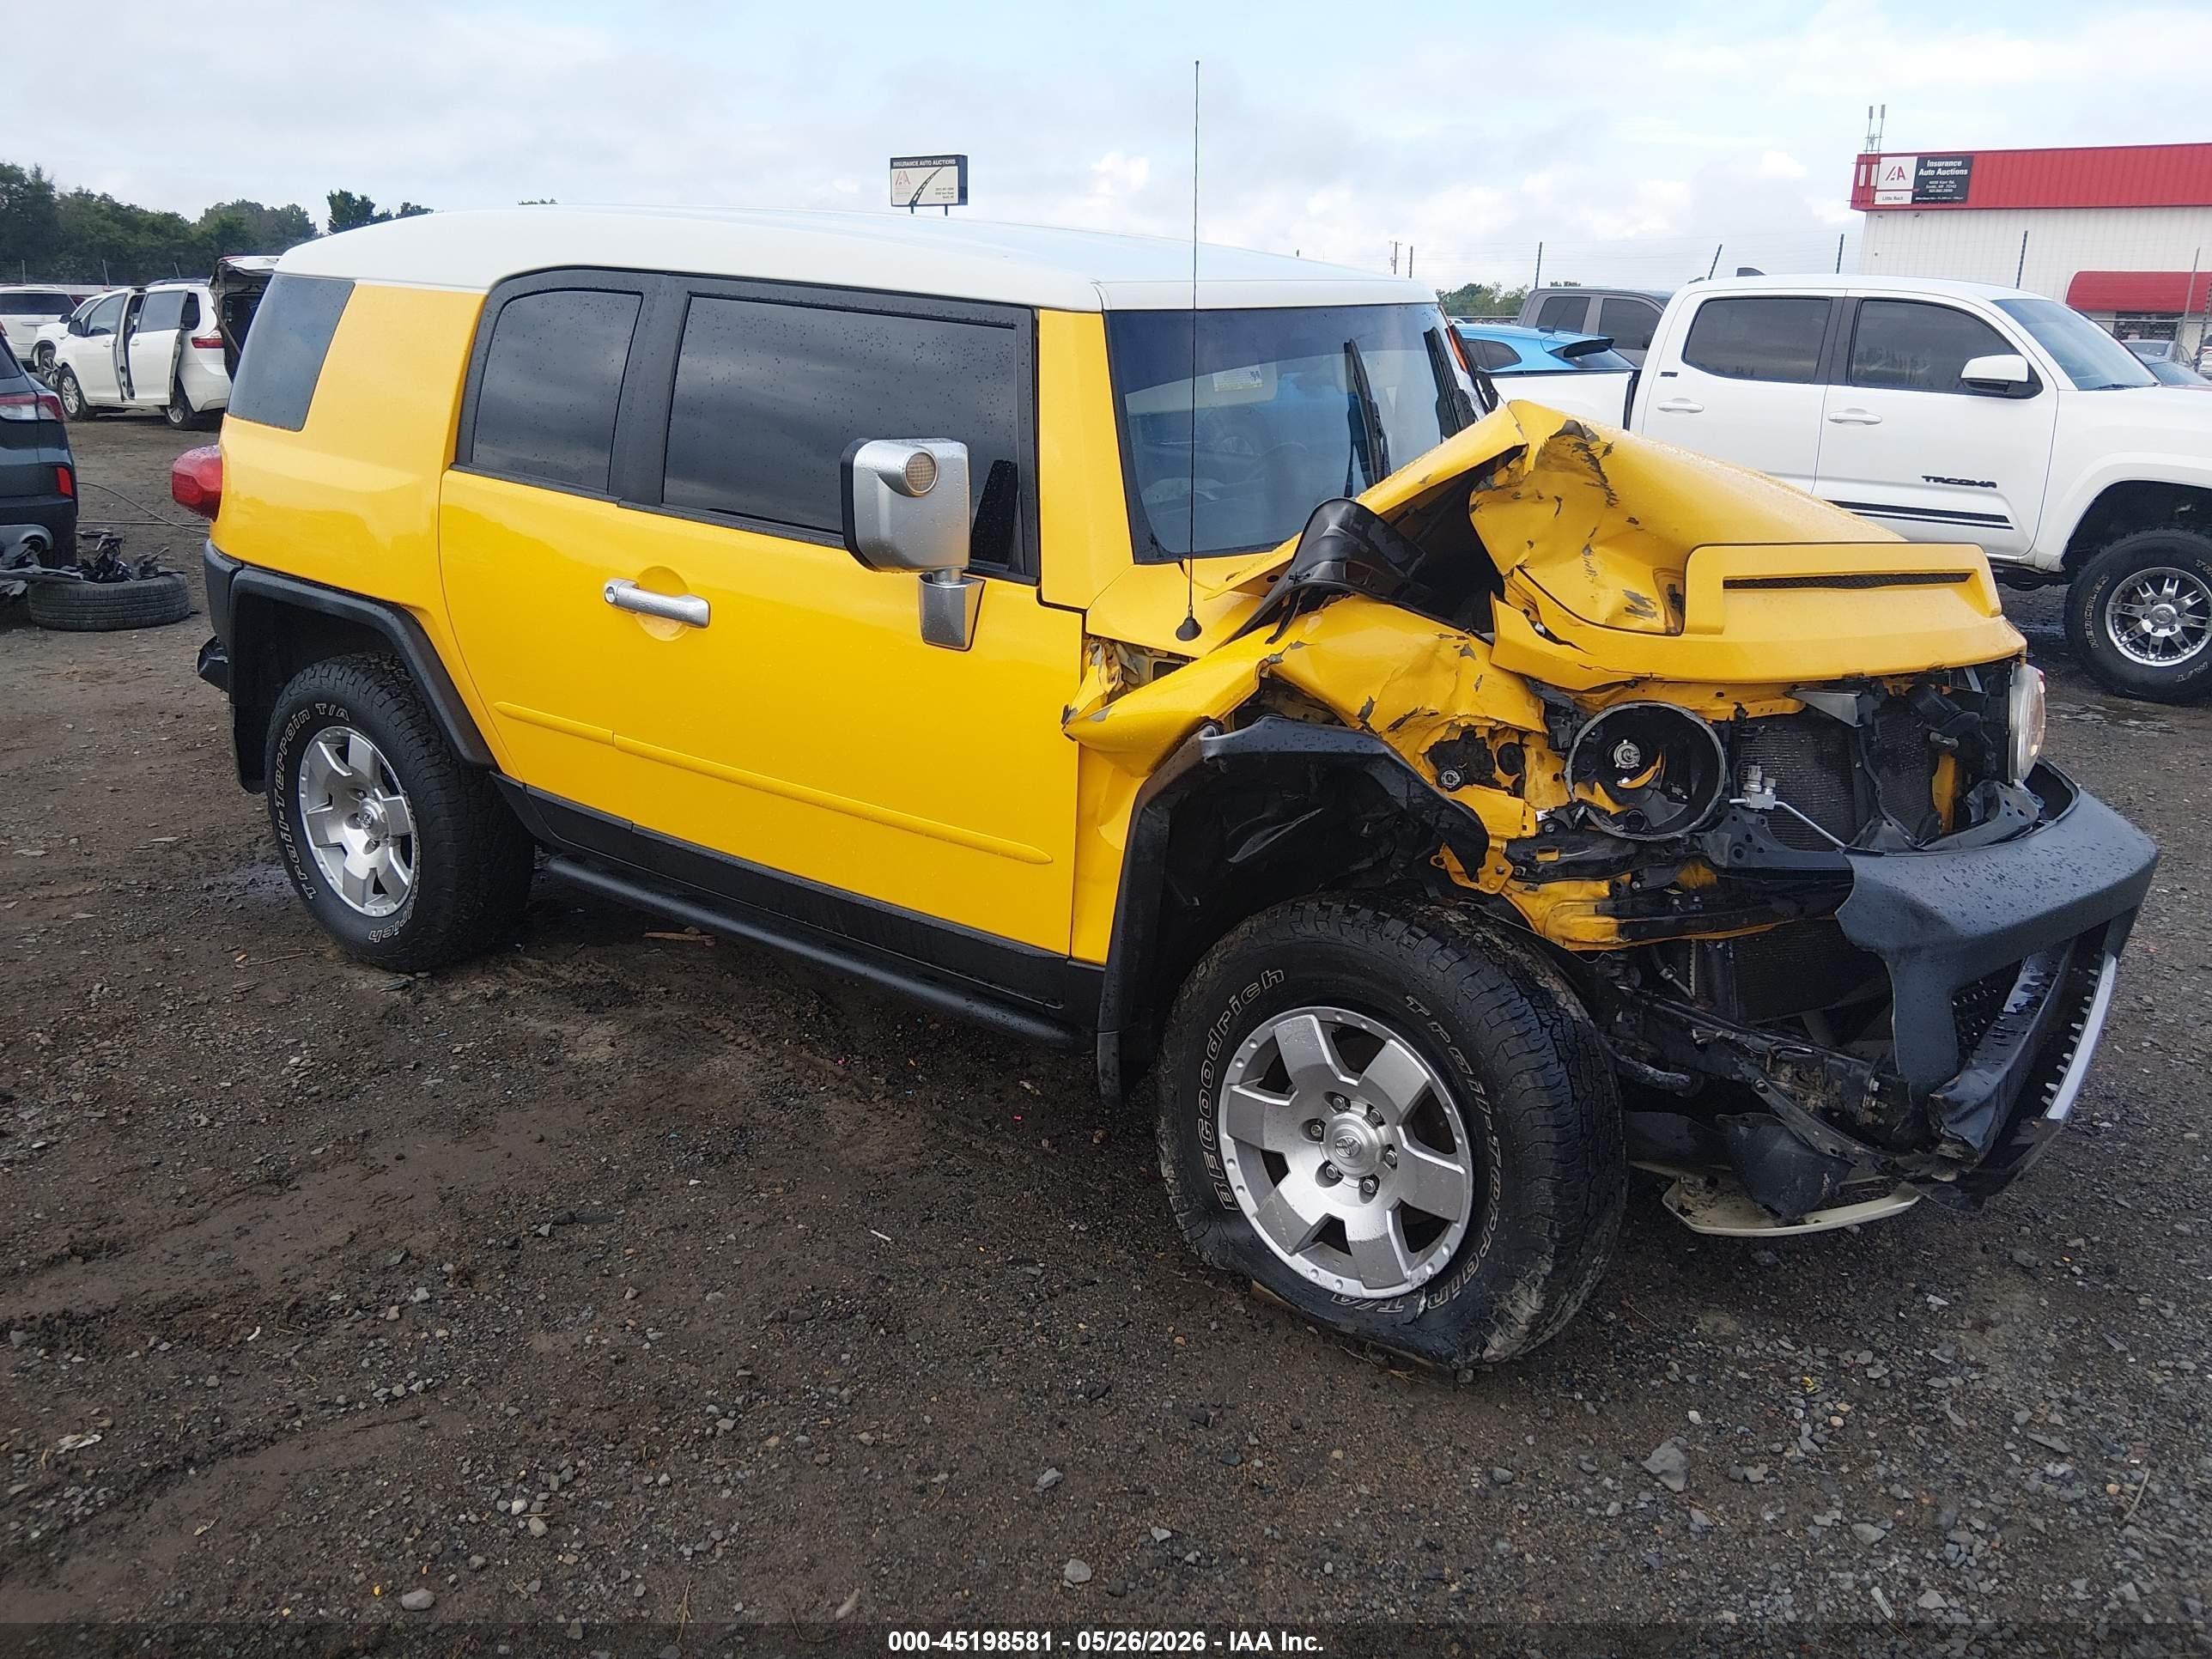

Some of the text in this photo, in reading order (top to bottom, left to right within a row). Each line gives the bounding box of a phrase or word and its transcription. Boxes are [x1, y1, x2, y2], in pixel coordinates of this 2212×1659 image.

[1936, 167, 1968, 176] Auctions
[1921, 475, 1997, 489] TACOMA
[314, 702, 351, 723] T/A
[1196, 968, 1285, 1212] BFGoodrich
